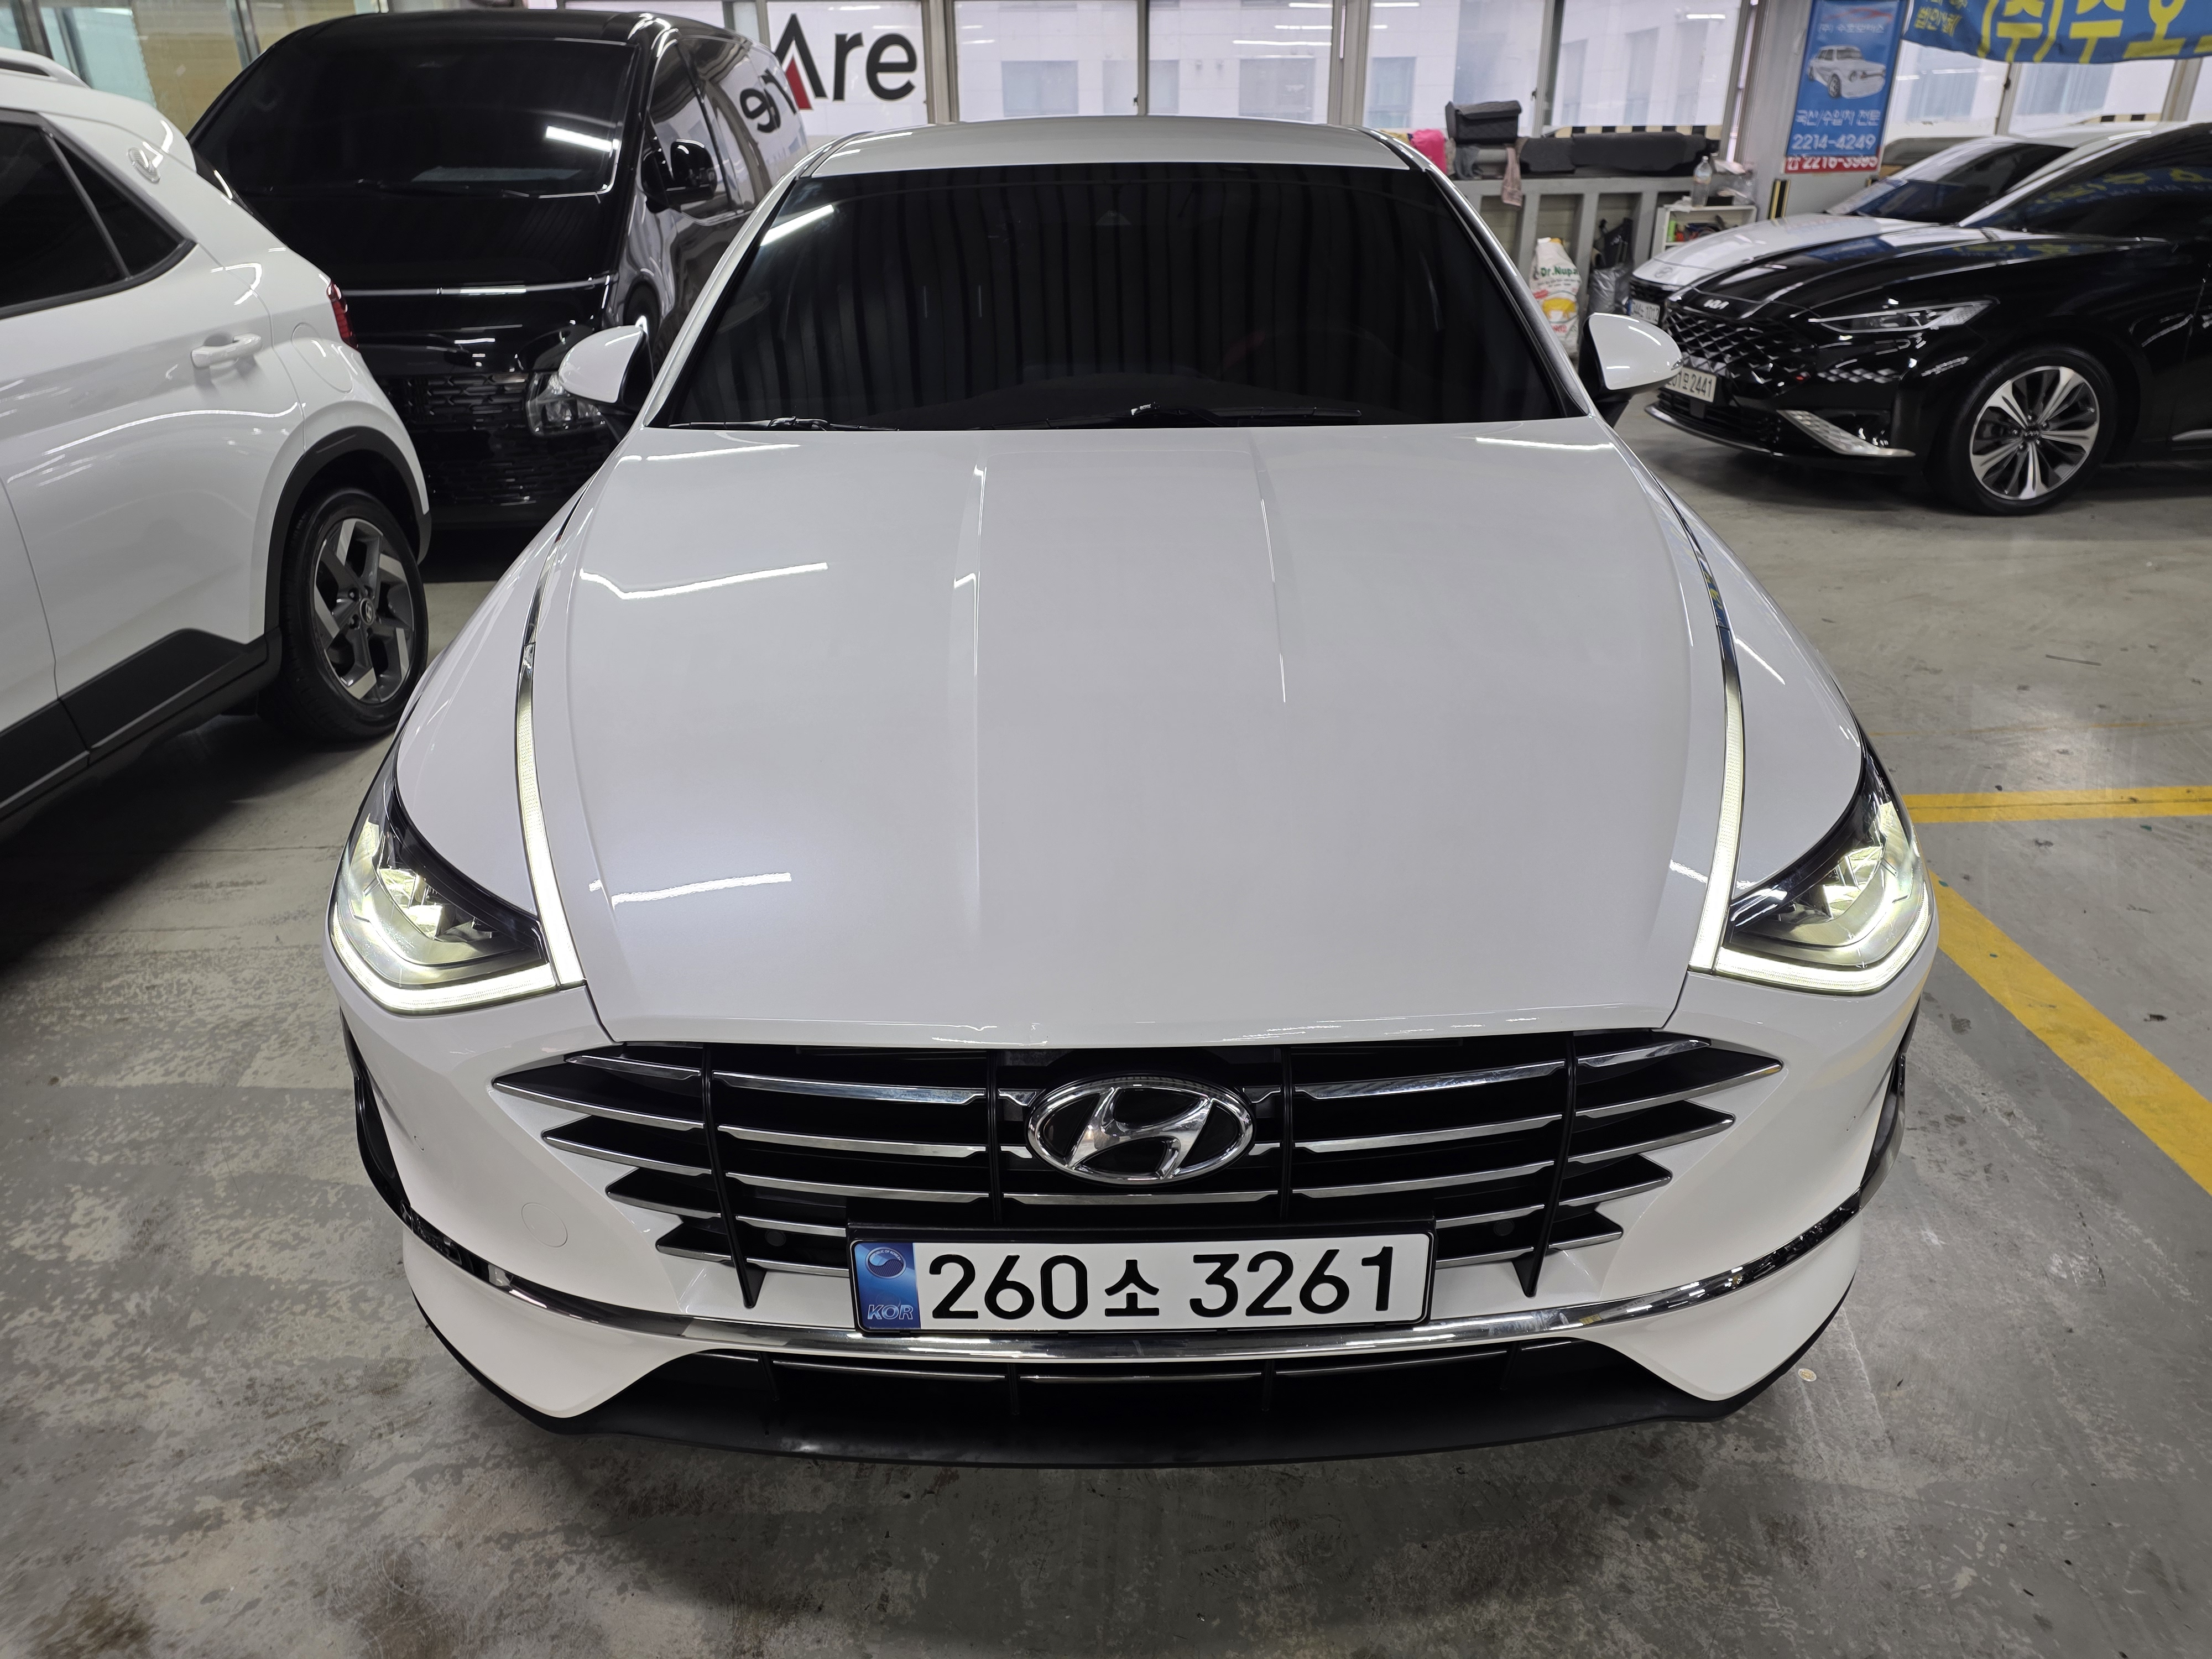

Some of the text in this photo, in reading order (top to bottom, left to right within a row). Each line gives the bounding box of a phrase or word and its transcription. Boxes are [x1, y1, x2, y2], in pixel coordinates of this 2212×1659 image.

[1796, 109, 1855, 127] 국산/수입차
[1791, 133, 1876, 150] 2214-4249
[1691, 373, 1713, 398] 2441
[929, 1246, 1394, 1319] 260소 3261
[868, 1305, 913, 1319] KOR
